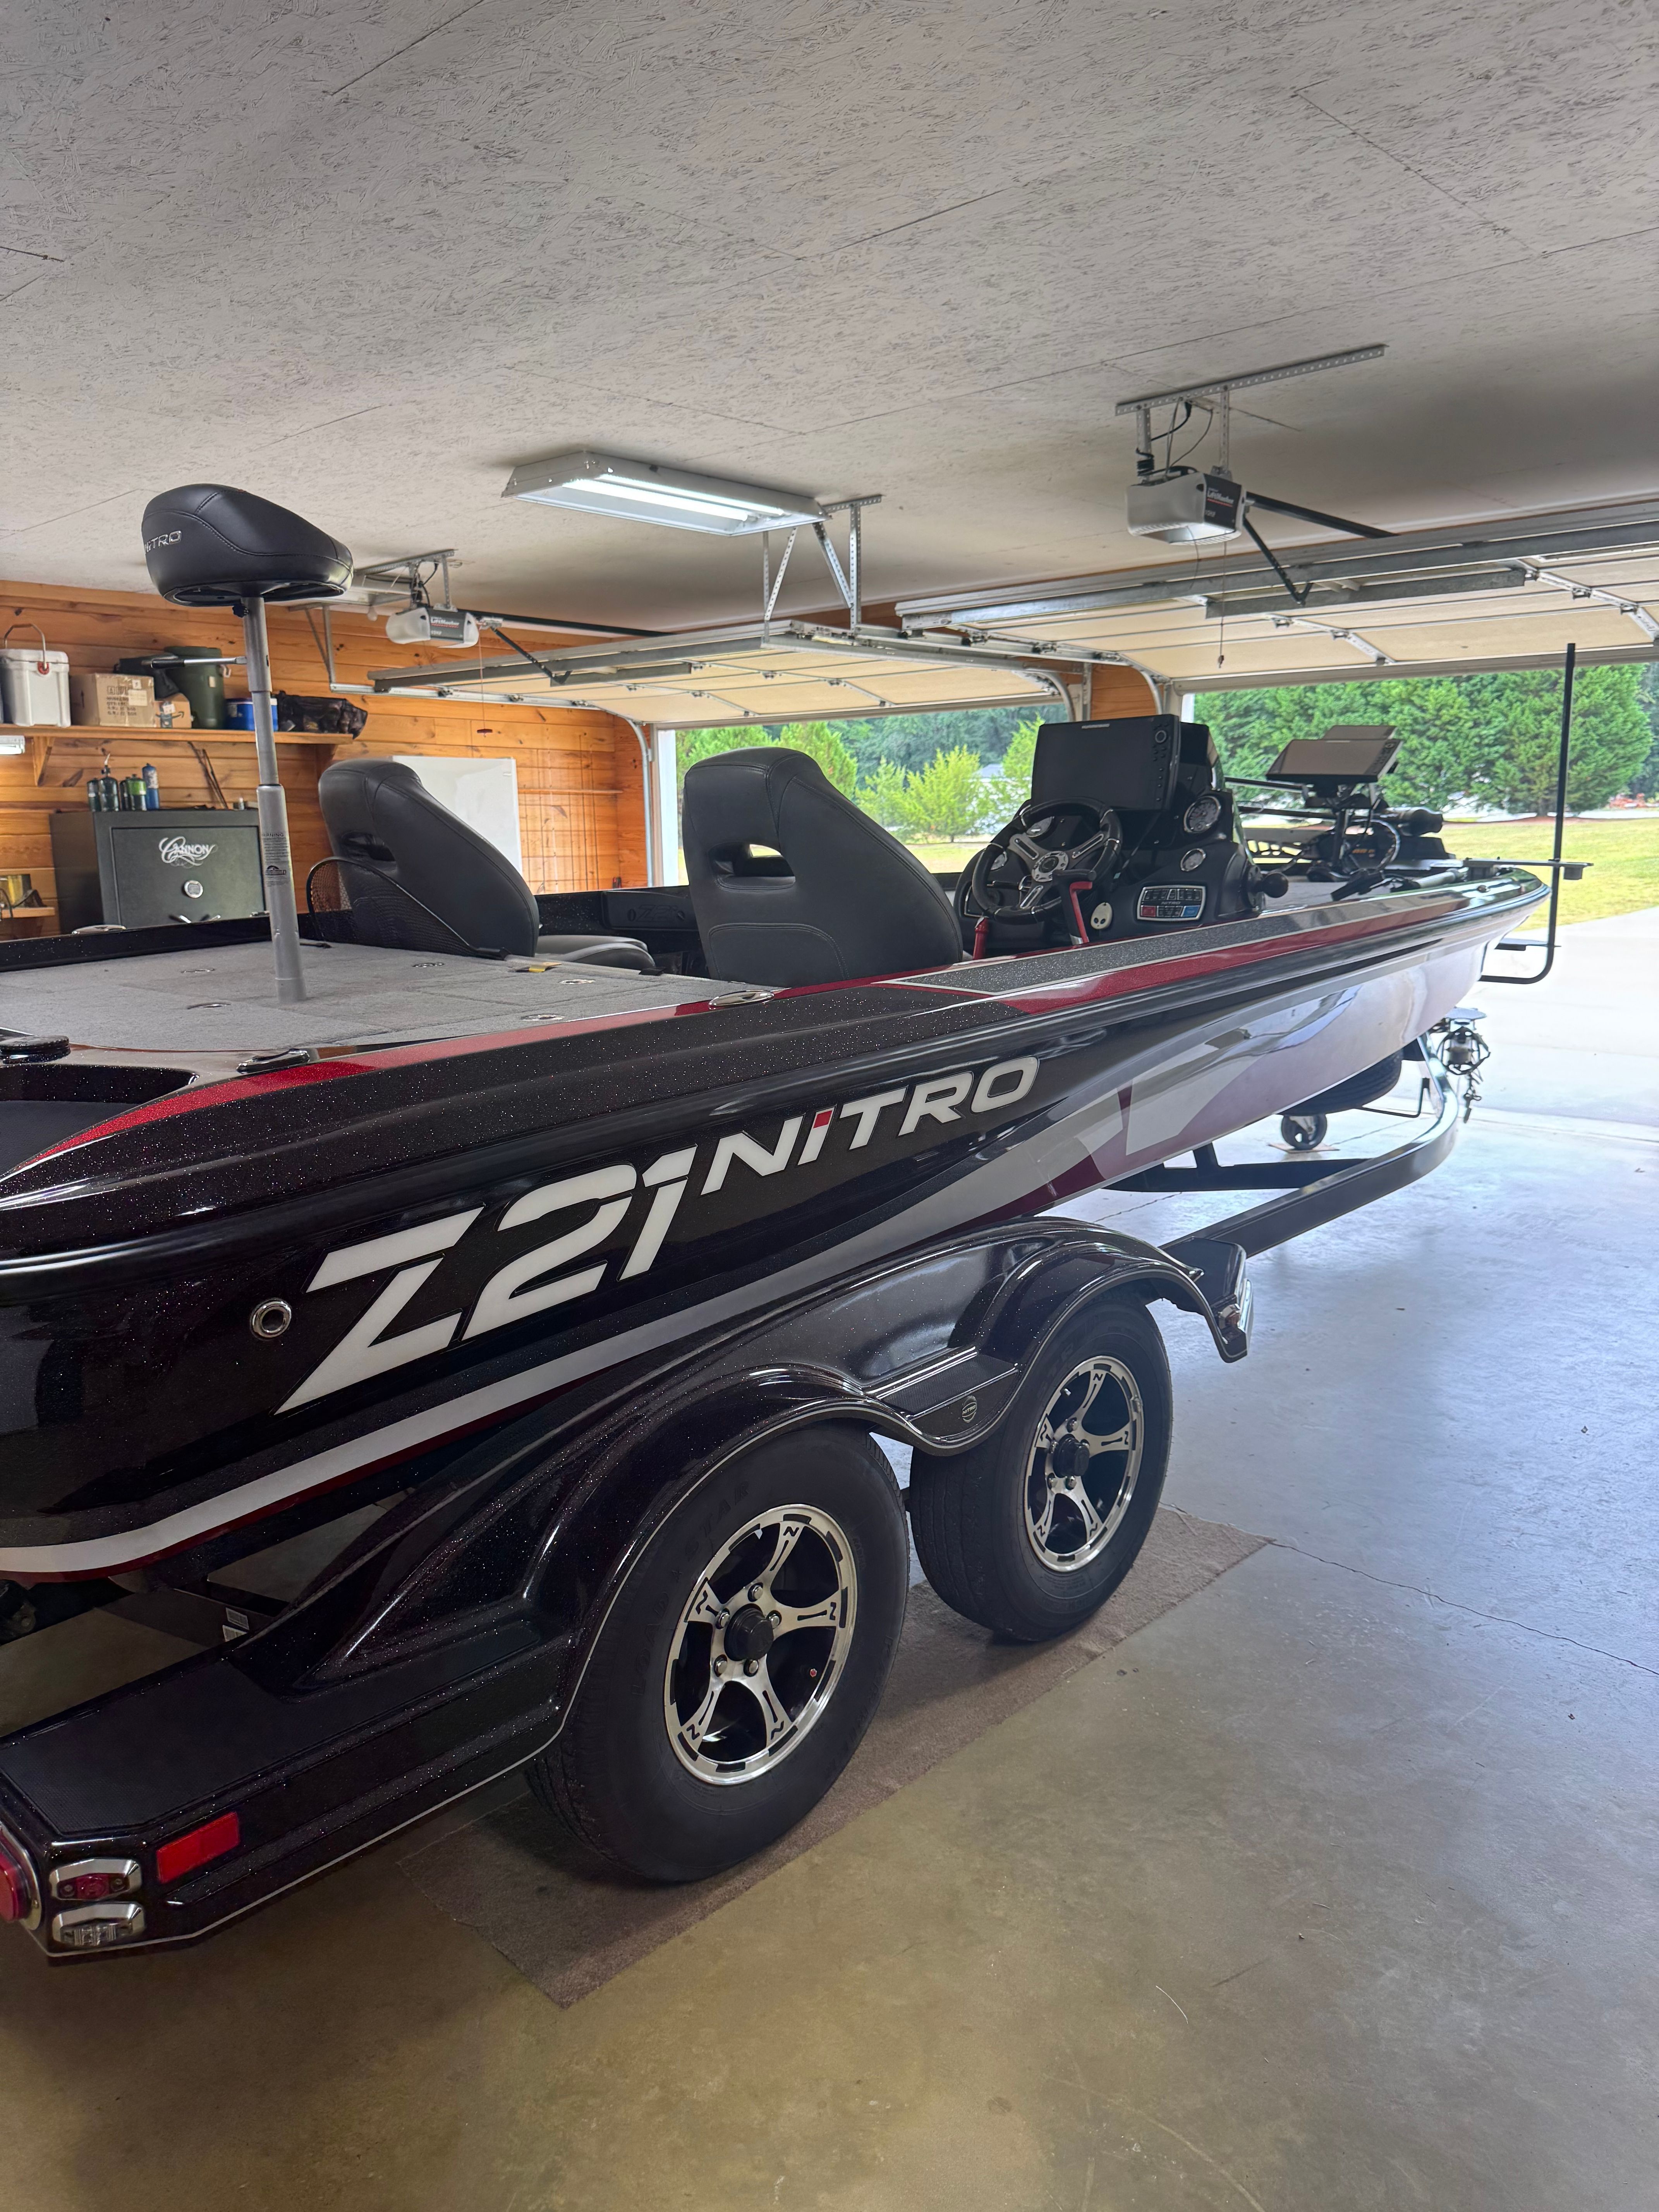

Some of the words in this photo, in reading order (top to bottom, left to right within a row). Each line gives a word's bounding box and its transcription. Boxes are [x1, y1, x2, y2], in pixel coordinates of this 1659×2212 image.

[274, 1146, 697, 1414] Z21
[702, 1057, 1040, 1194] NITRO
[962, 1405, 976, 1415] NITRO
